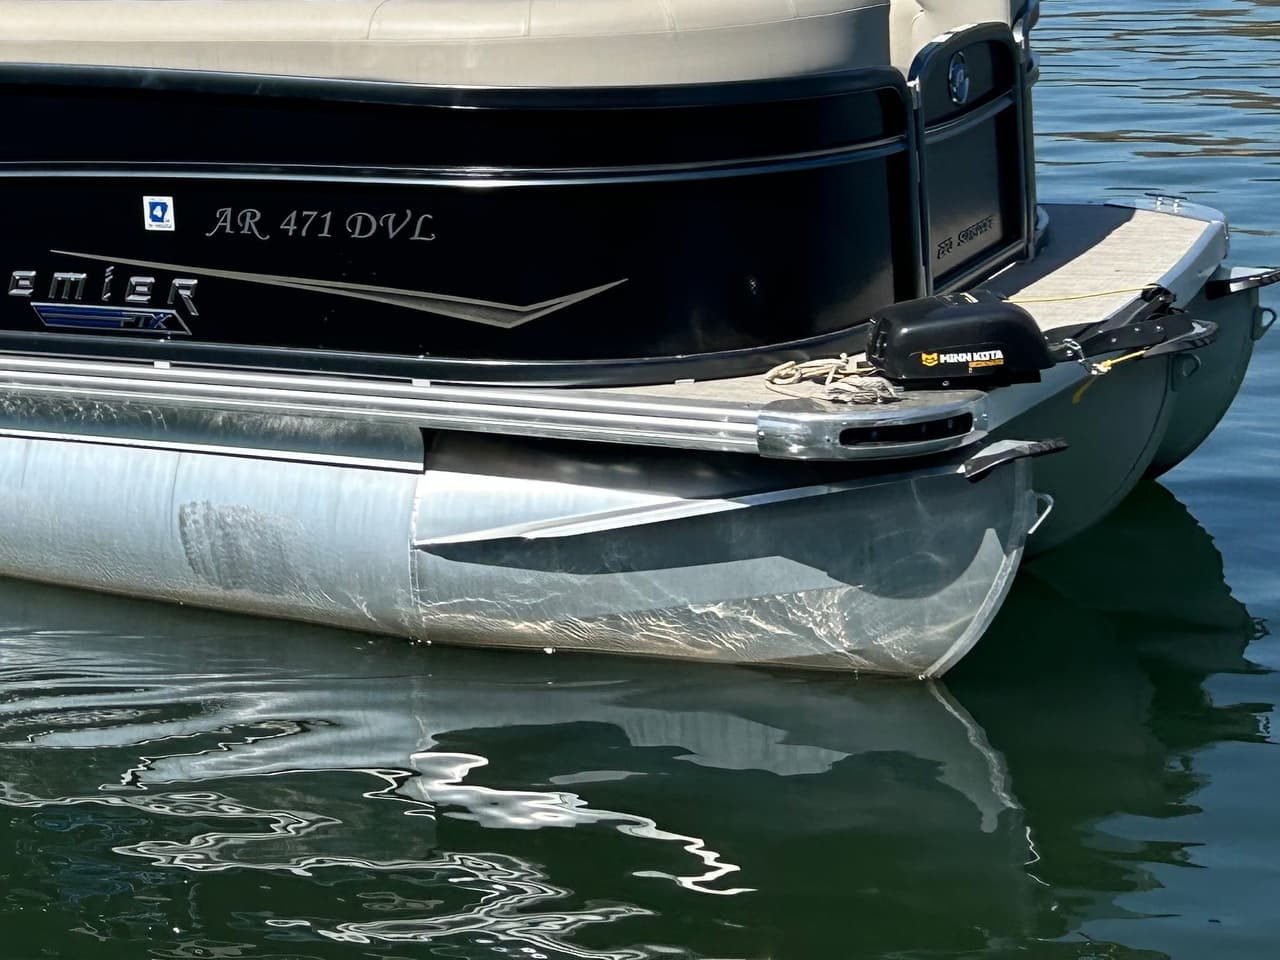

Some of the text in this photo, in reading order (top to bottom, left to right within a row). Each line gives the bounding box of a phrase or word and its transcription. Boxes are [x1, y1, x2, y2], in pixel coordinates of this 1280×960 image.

[205, 207, 436, 241] AR 471 DVL
[940, 350, 1004, 363] MINN KOTA
